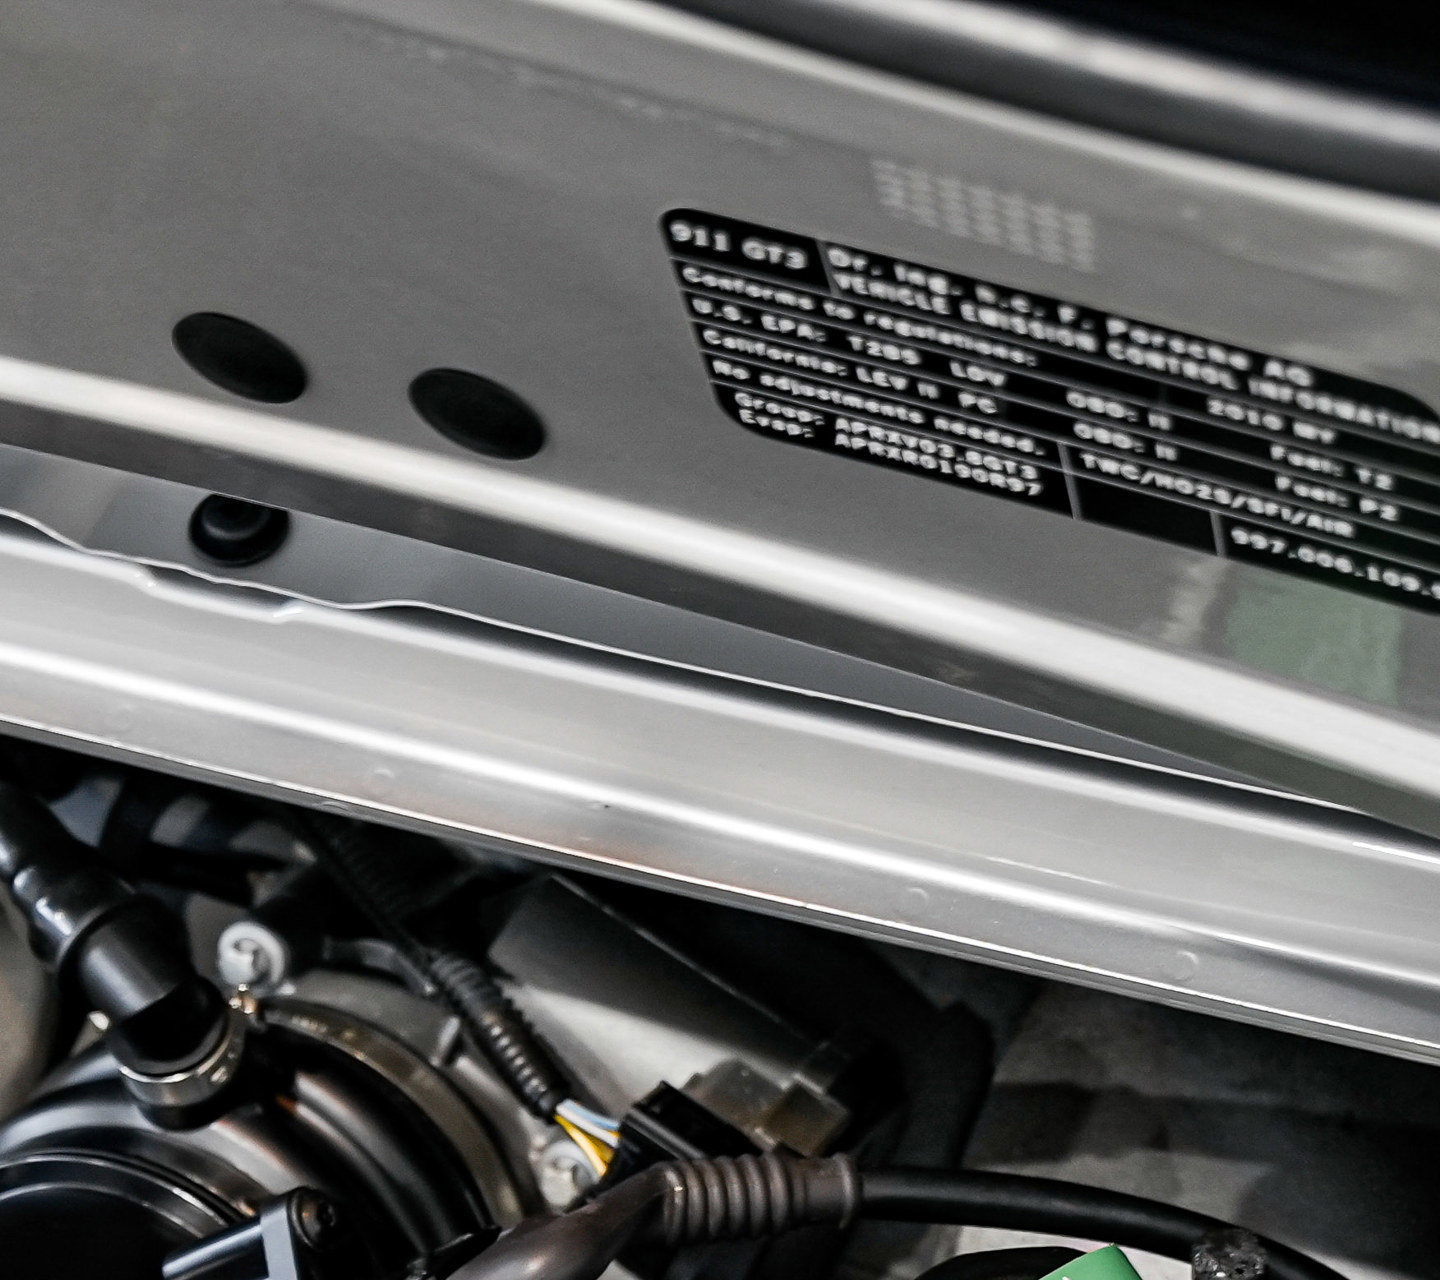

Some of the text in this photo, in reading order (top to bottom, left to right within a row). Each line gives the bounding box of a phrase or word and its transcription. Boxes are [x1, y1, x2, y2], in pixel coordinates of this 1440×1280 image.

[668, 220, 805, 269] 911 GT3
[827, 248, 880, 275] Dr.
[895, 265, 960, 295] Ing.
